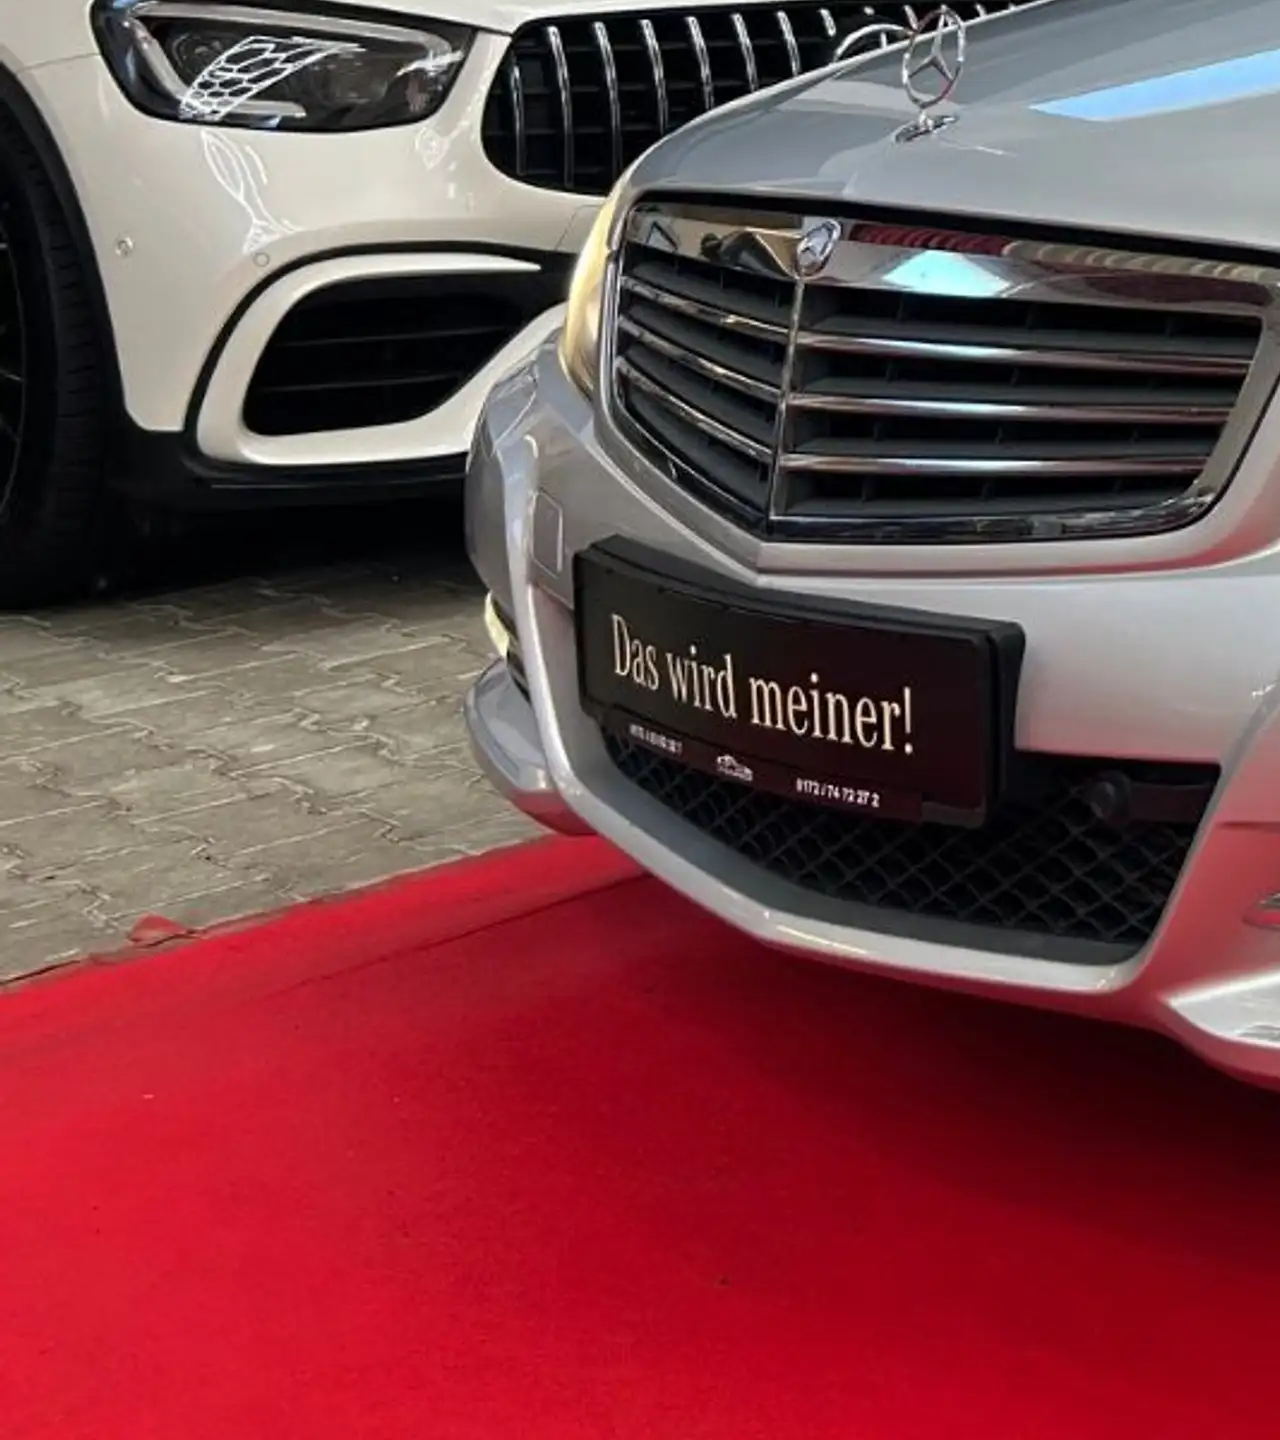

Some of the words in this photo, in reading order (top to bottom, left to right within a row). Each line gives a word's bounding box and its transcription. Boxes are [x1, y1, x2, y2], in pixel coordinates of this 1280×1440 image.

[610, 613, 660, 691] Das
[665, 644, 737, 719] wird
[749, 672, 914, 754] meiner!
